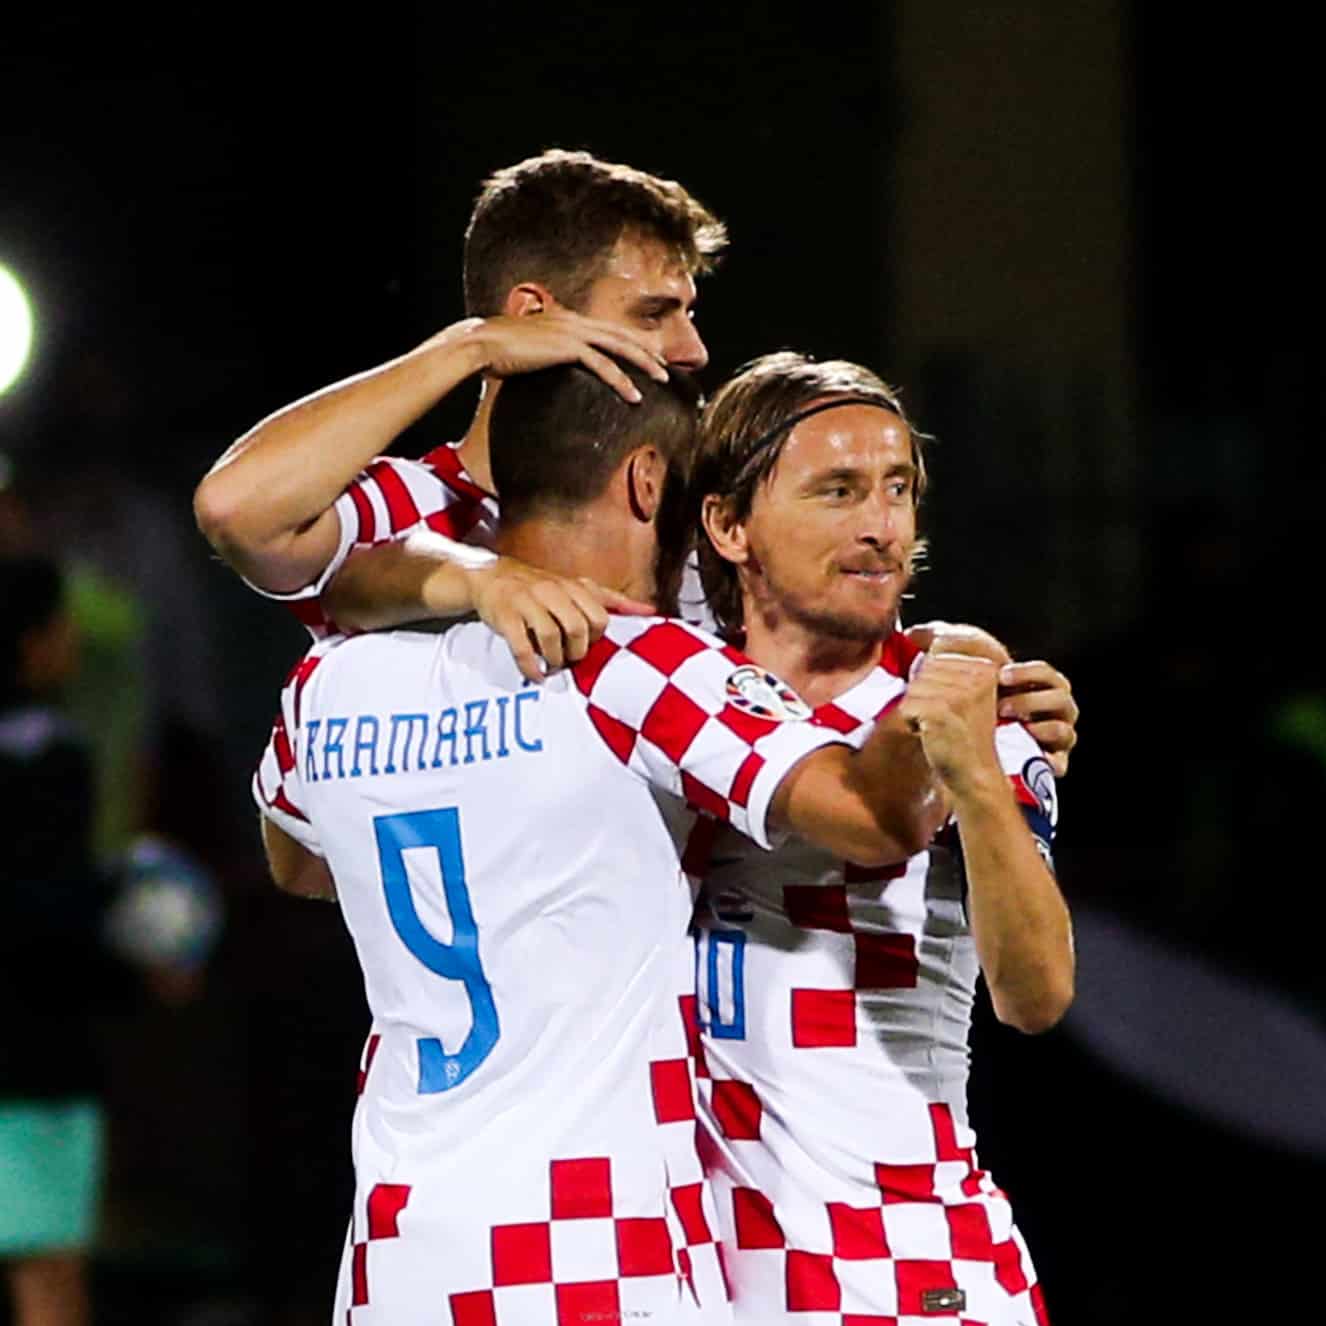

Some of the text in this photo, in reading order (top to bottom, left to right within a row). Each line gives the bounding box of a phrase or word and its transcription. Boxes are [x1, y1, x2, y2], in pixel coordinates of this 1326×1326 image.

[305, 680, 543, 783] KRAMARIĆ
[373, 806, 501, 1095] 9
[695, 929, 747, 1041] 0
